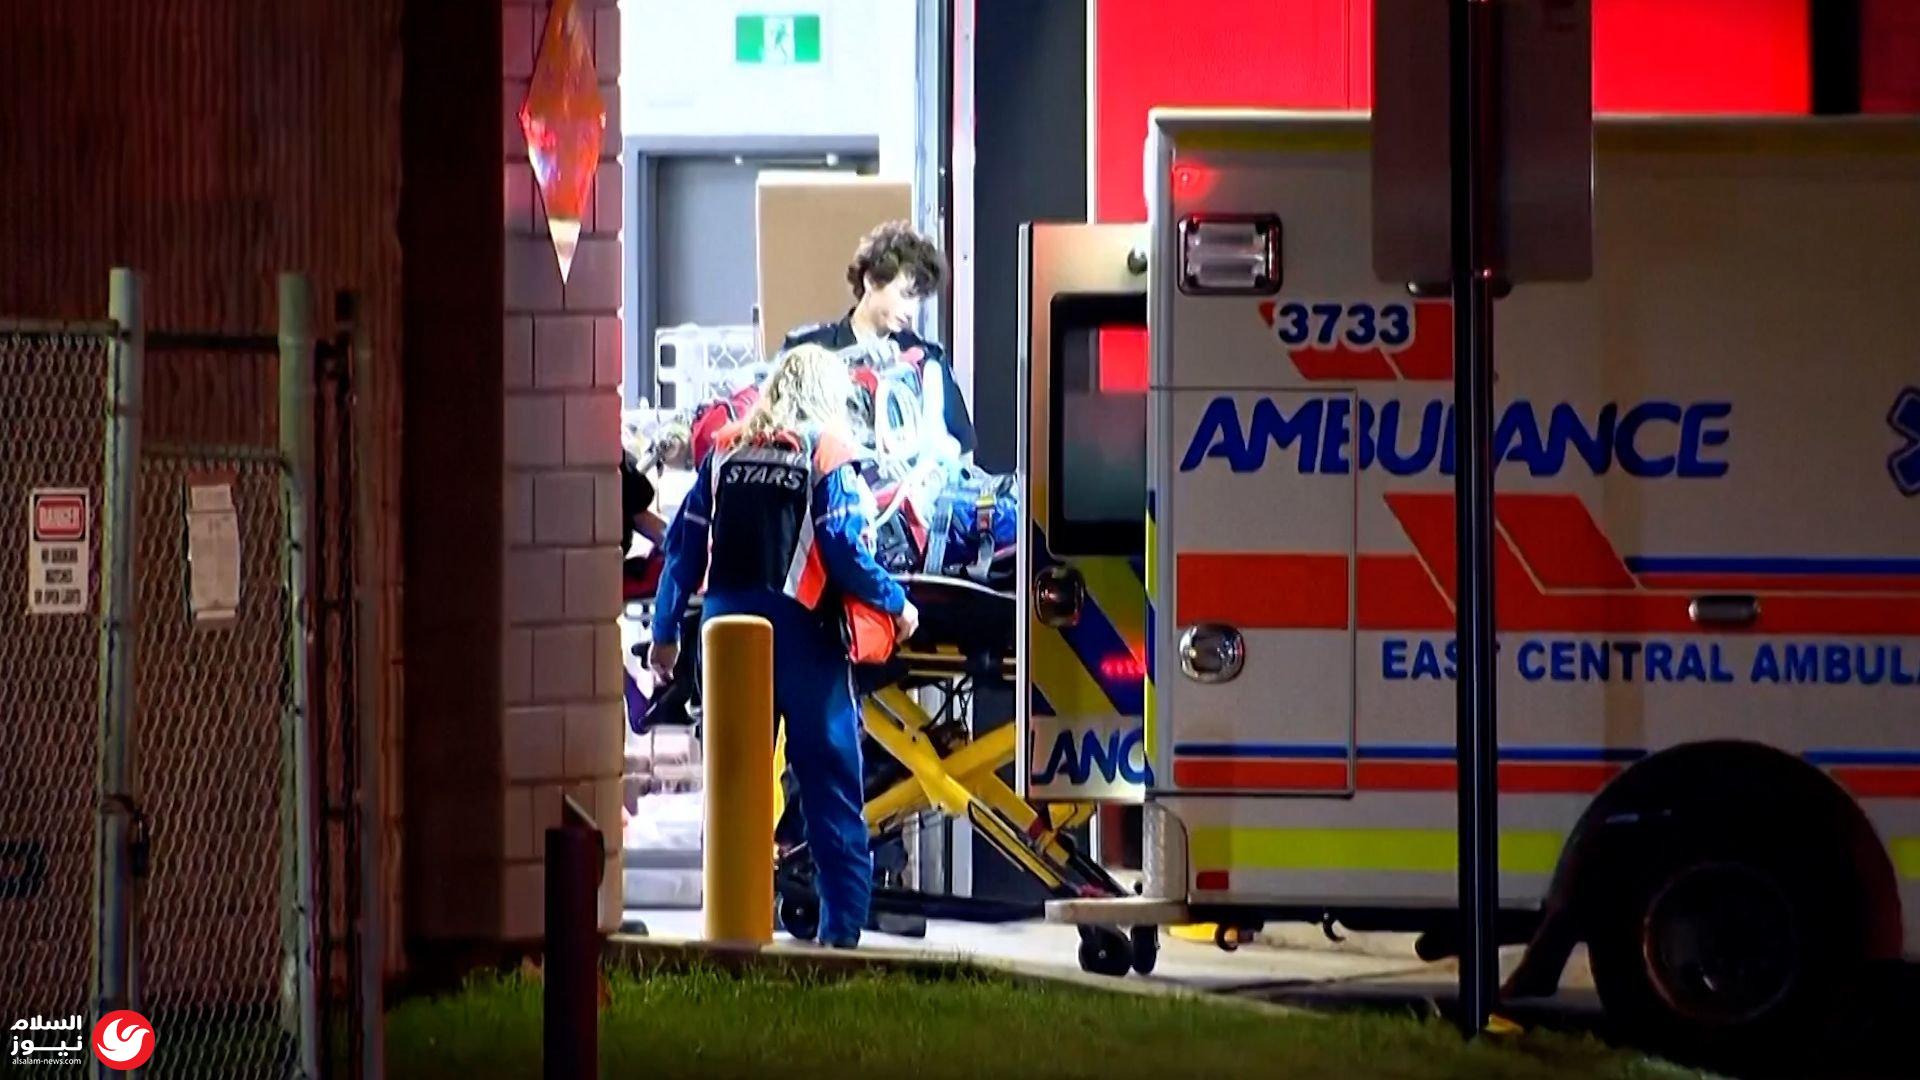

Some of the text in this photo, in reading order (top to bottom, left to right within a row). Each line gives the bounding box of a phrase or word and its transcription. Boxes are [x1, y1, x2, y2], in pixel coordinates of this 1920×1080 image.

[1278, 303, 1411, 346] 3733
[726, 465, 804, 491] STARS
[1517, 640, 1735, 684] CENTRAL
[1750, 642, 1920, 685] AMBUL
